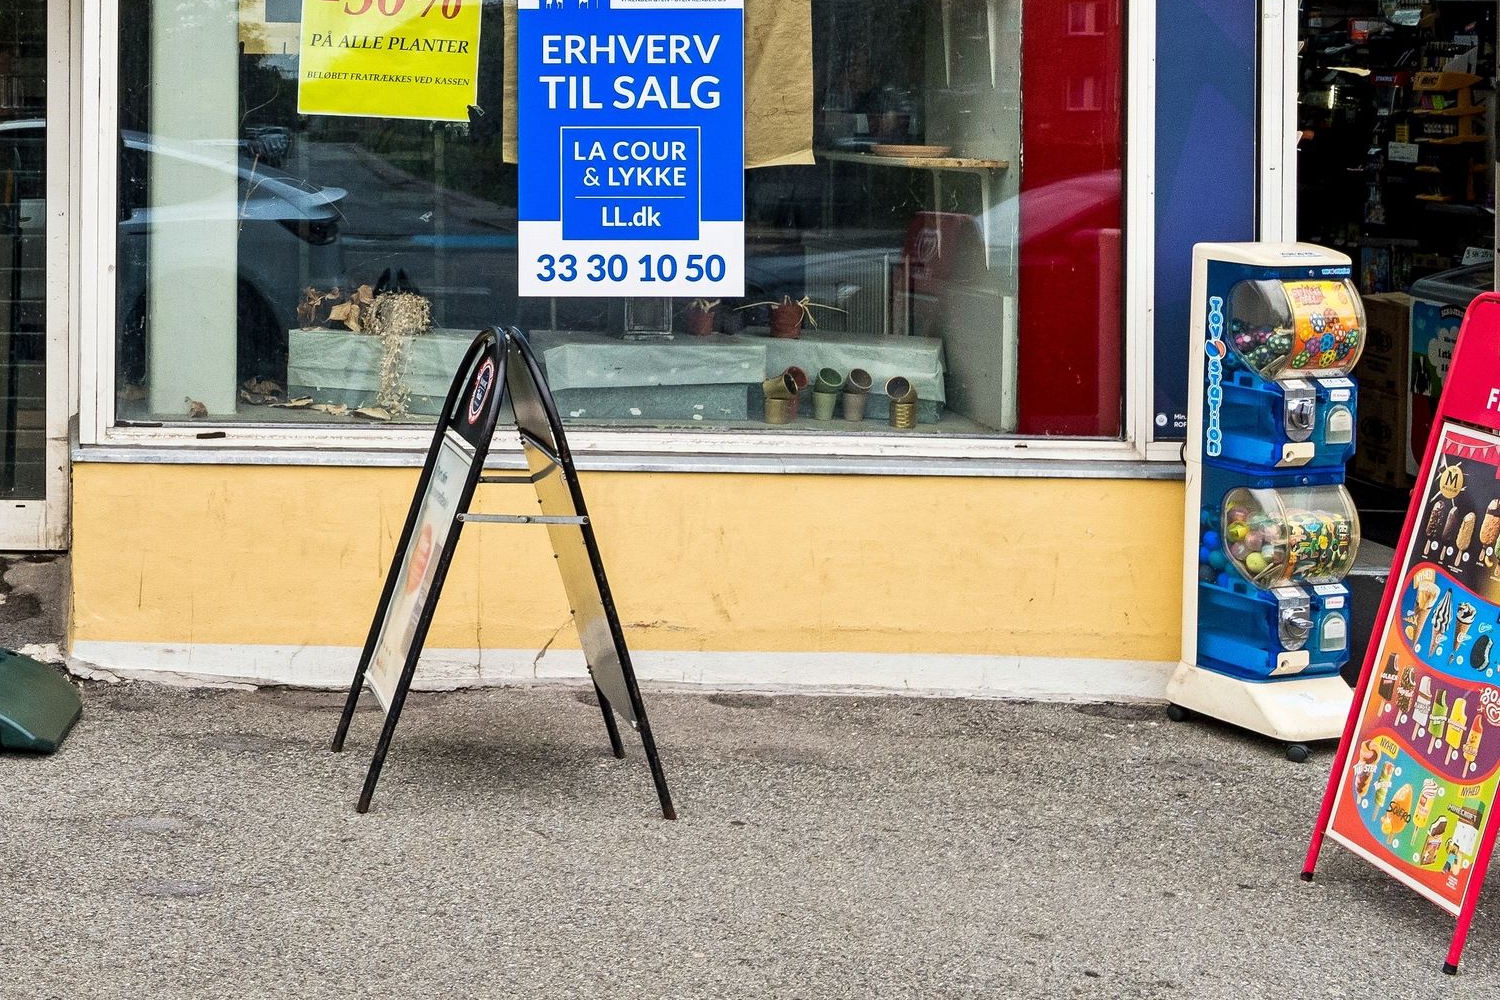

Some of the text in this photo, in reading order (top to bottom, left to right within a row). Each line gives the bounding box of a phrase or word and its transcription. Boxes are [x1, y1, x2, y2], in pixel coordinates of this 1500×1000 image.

[309, 30, 470, 54] PÅ ALLE PLANTER
[542, 34, 721, 65] ERHVERV
[307, 70, 471, 87] BELØBET FRATRÆKKES VED KASSEN
[539, 75, 604, 110] TIL
[612, 74, 721, 110] SALG
[573, 141, 688, 161] LA COUR
[583, 166, 688, 187] & LYKKE
[601, 206, 662, 228] LL.dk
[536, 253, 726, 283] 33 30 10 50
[1379, 737, 1398, 755] NYHED
[1460, 785, 1482, 797] NYHED
[1386, 800, 1412, 825] SOLERO
